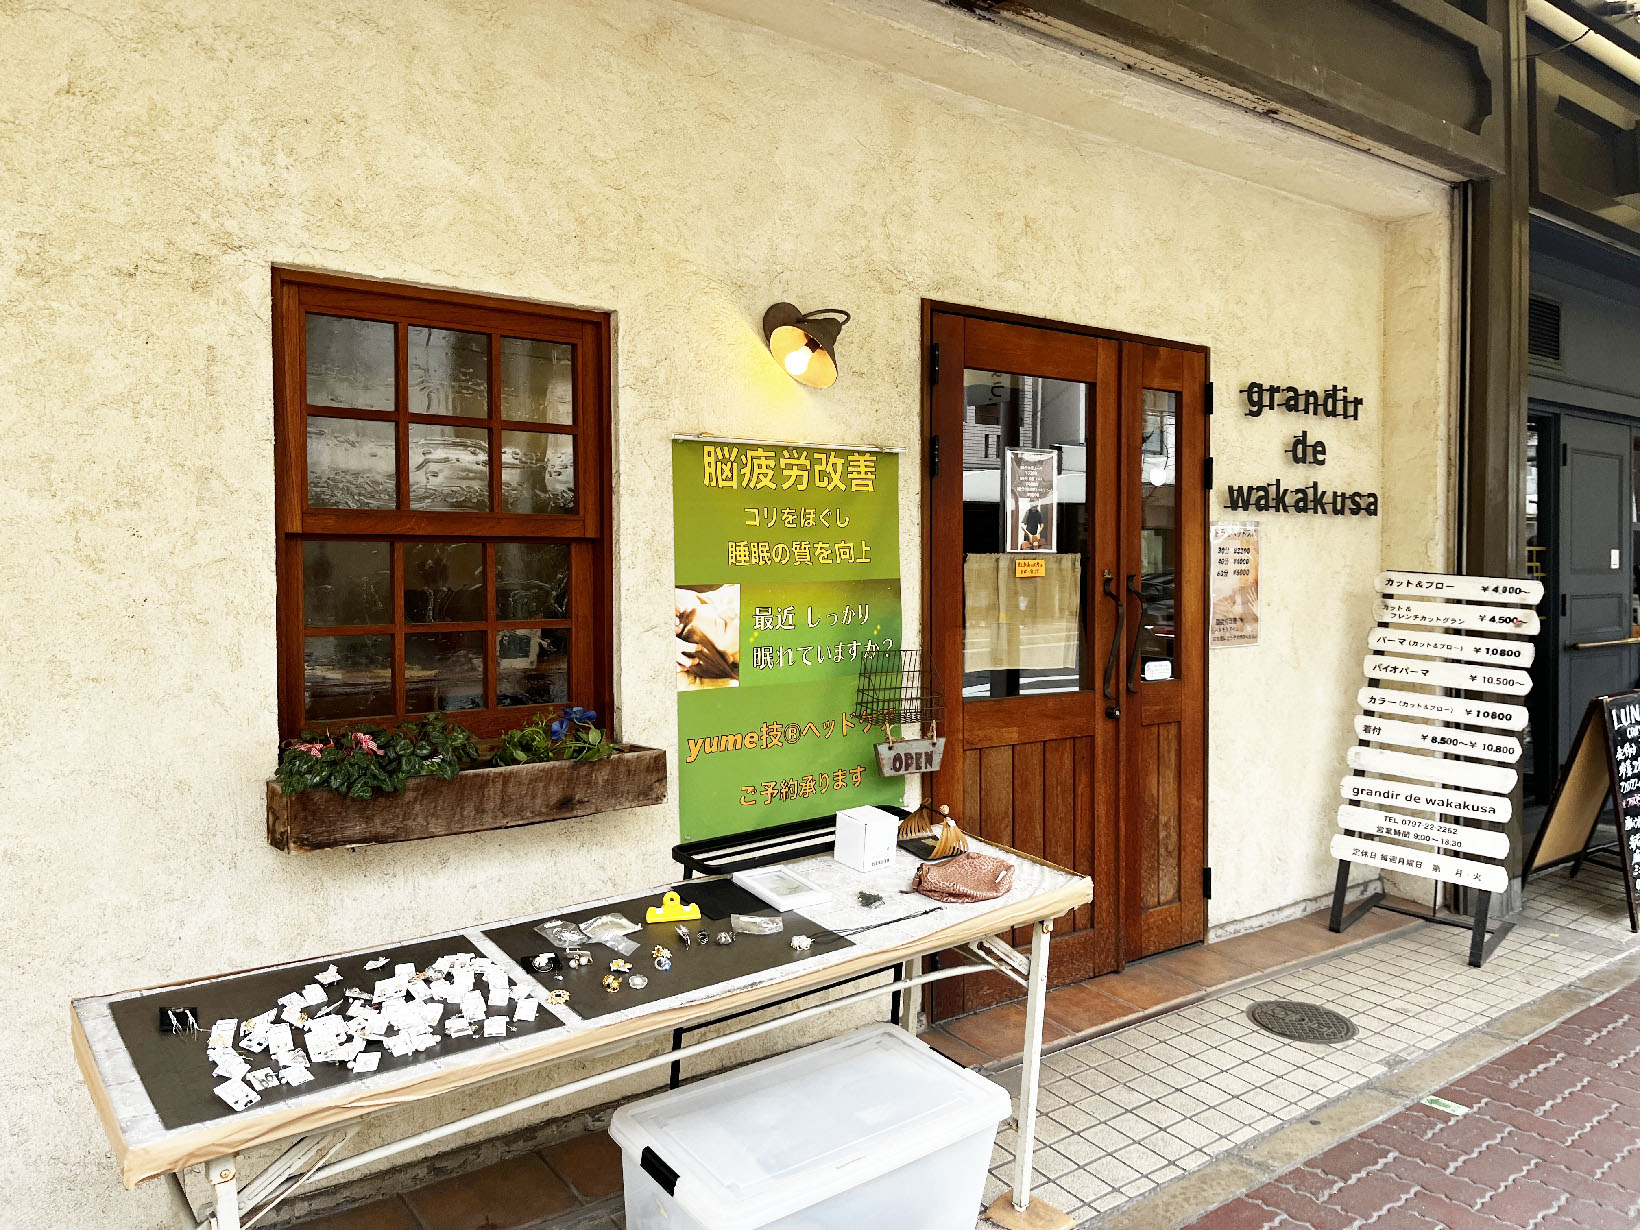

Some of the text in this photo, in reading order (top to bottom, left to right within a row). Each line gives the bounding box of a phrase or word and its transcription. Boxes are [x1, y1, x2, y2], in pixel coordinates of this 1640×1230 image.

[1245, 381, 1364, 420] grandir
[1291, 431, 1327, 466] de
[702, 445, 878, 493] 脳疲労改善
[1227, 478, 1379, 516] wakakusa
[743, 507, 851, 529] コリをほぐし
[727, 540, 872, 567] 睡眠の質を向上
[752, 604, 870, 631] 最近 しっかり
[892, 750, 934, 773] OPEN
[739, 765, 867, 806] ご予約承ります
[1352, 785, 1497, 815] grandir de wakakusa
[1384, 815, 1399, 825] TEL
